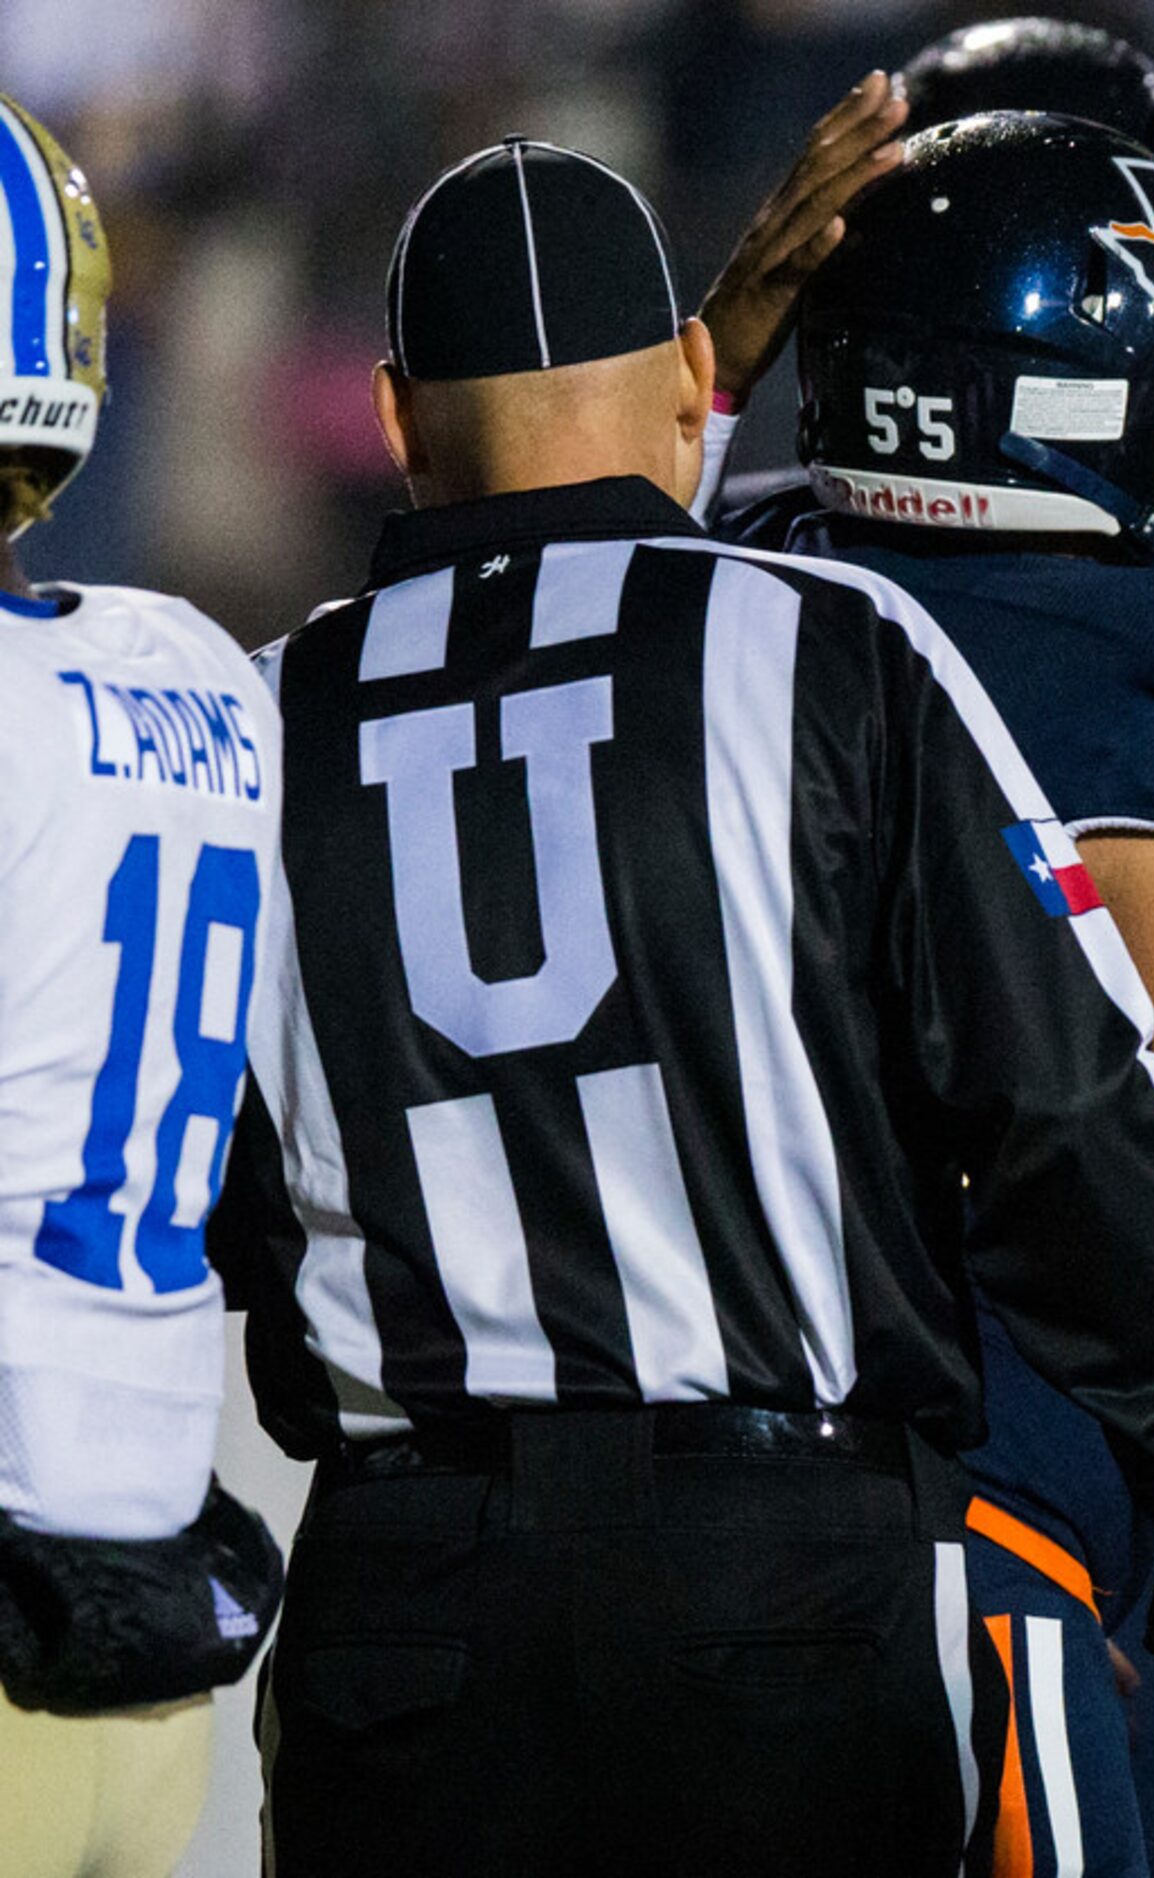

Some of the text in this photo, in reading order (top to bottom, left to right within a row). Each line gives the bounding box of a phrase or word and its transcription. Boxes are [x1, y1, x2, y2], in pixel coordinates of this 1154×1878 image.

[864, 386, 956, 462] 55
[57, 671, 261, 801] Z.ADAMS
[359, 674, 619, 1058] U
[33, 833, 262, 1294] 18
